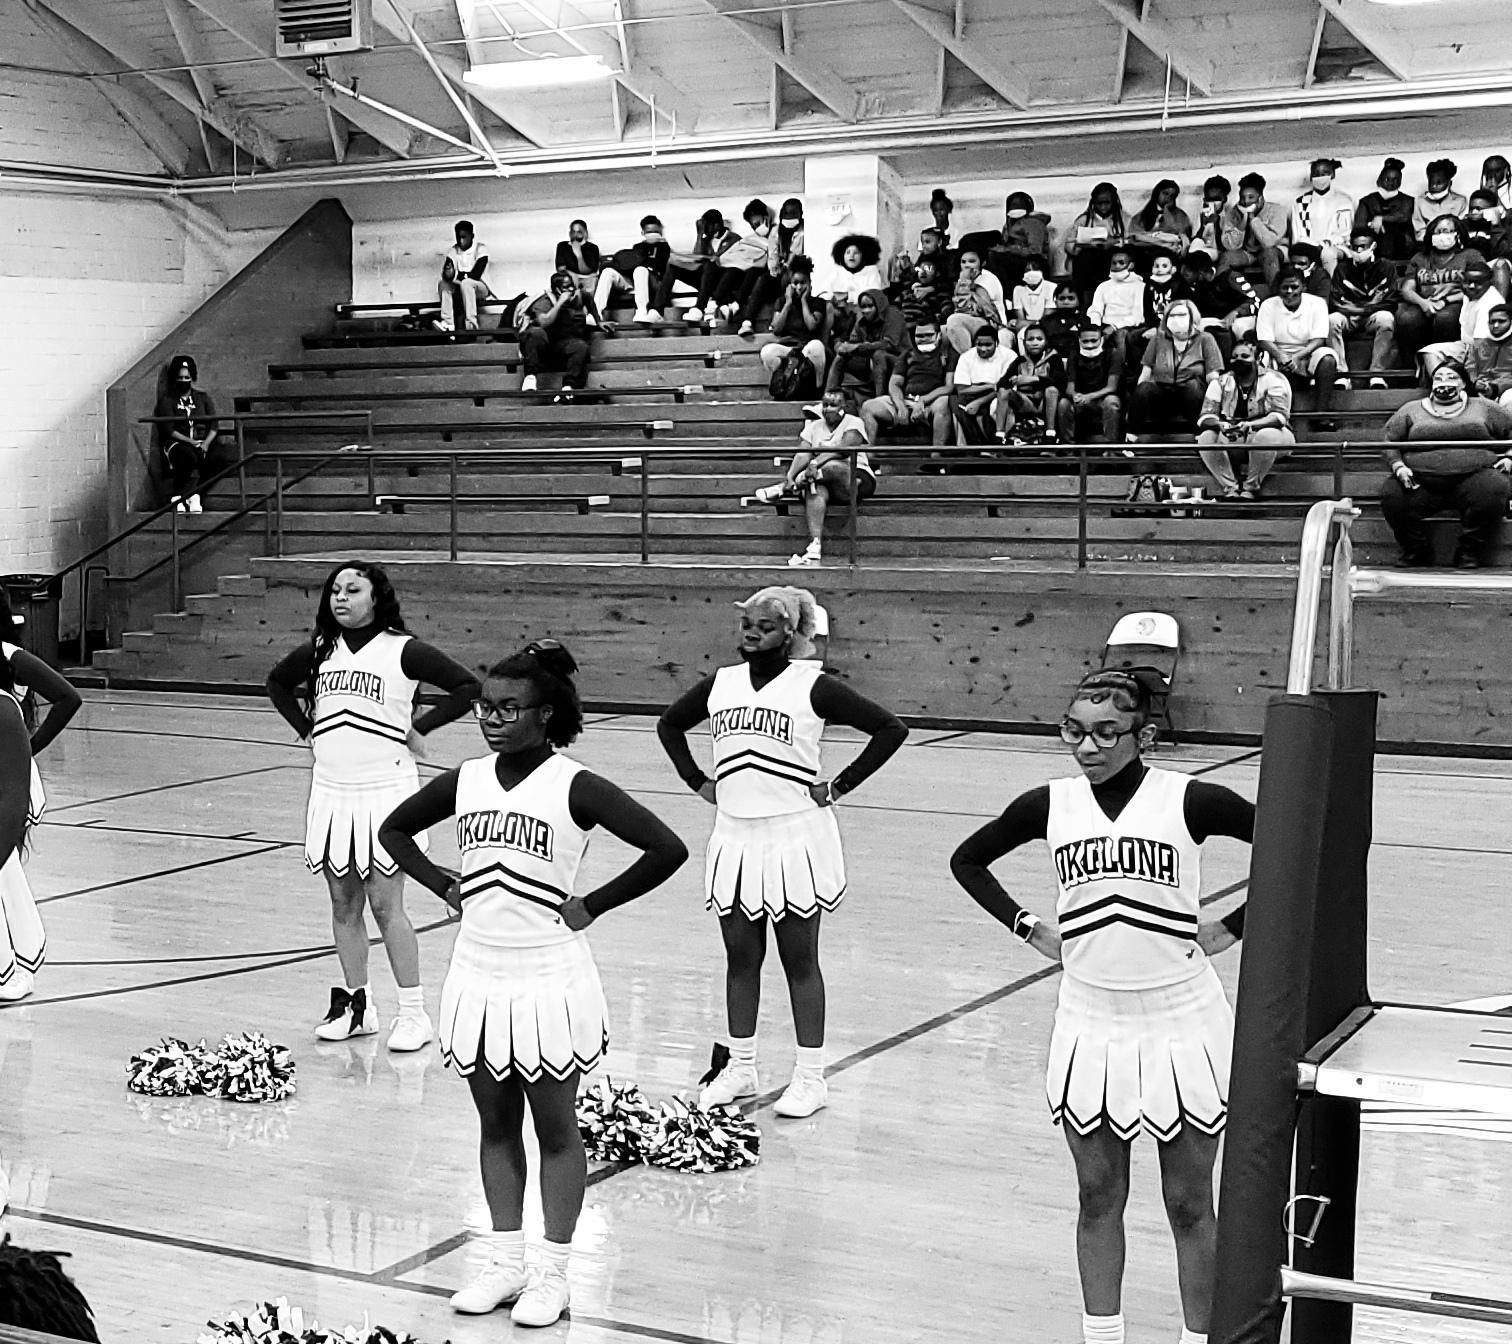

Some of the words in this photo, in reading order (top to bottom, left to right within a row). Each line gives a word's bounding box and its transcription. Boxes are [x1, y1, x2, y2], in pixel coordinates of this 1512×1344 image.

[712, 706, 794, 747] OKOLONA
[456, 810, 554, 863] OKOLONA
[1054, 836, 1179, 891] OKOLONA
